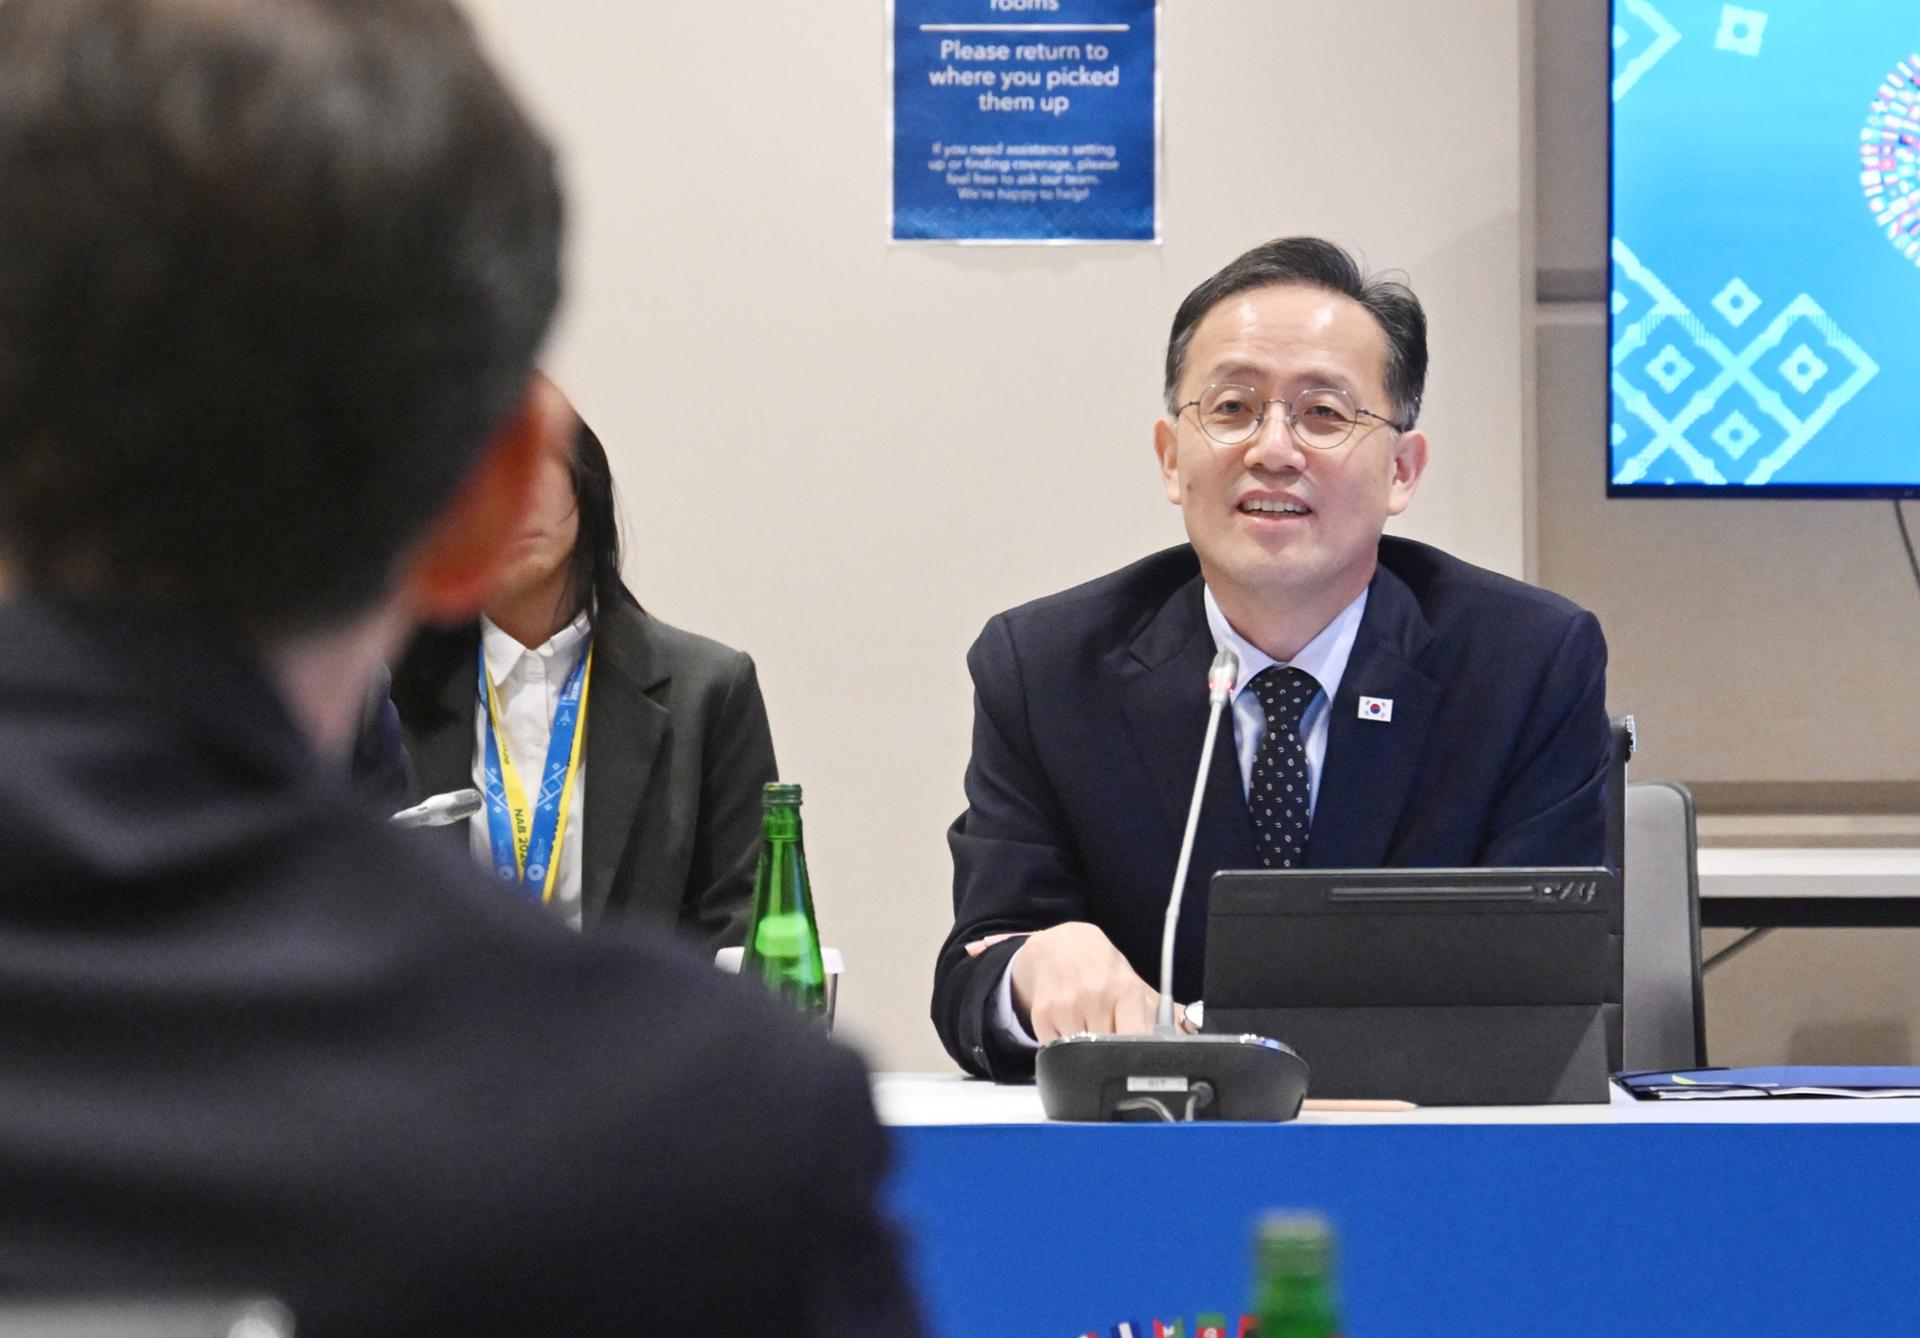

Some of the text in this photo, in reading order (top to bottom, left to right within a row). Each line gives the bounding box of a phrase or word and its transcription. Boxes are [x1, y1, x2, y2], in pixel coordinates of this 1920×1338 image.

[991, 0, 1060, 11] rooms
[940, 39, 1109, 61] Please return to
[929, 65, 1120, 91] where you picked
[979, 92, 1070, 116] them up
[514, 808, 527, 834] NAB
